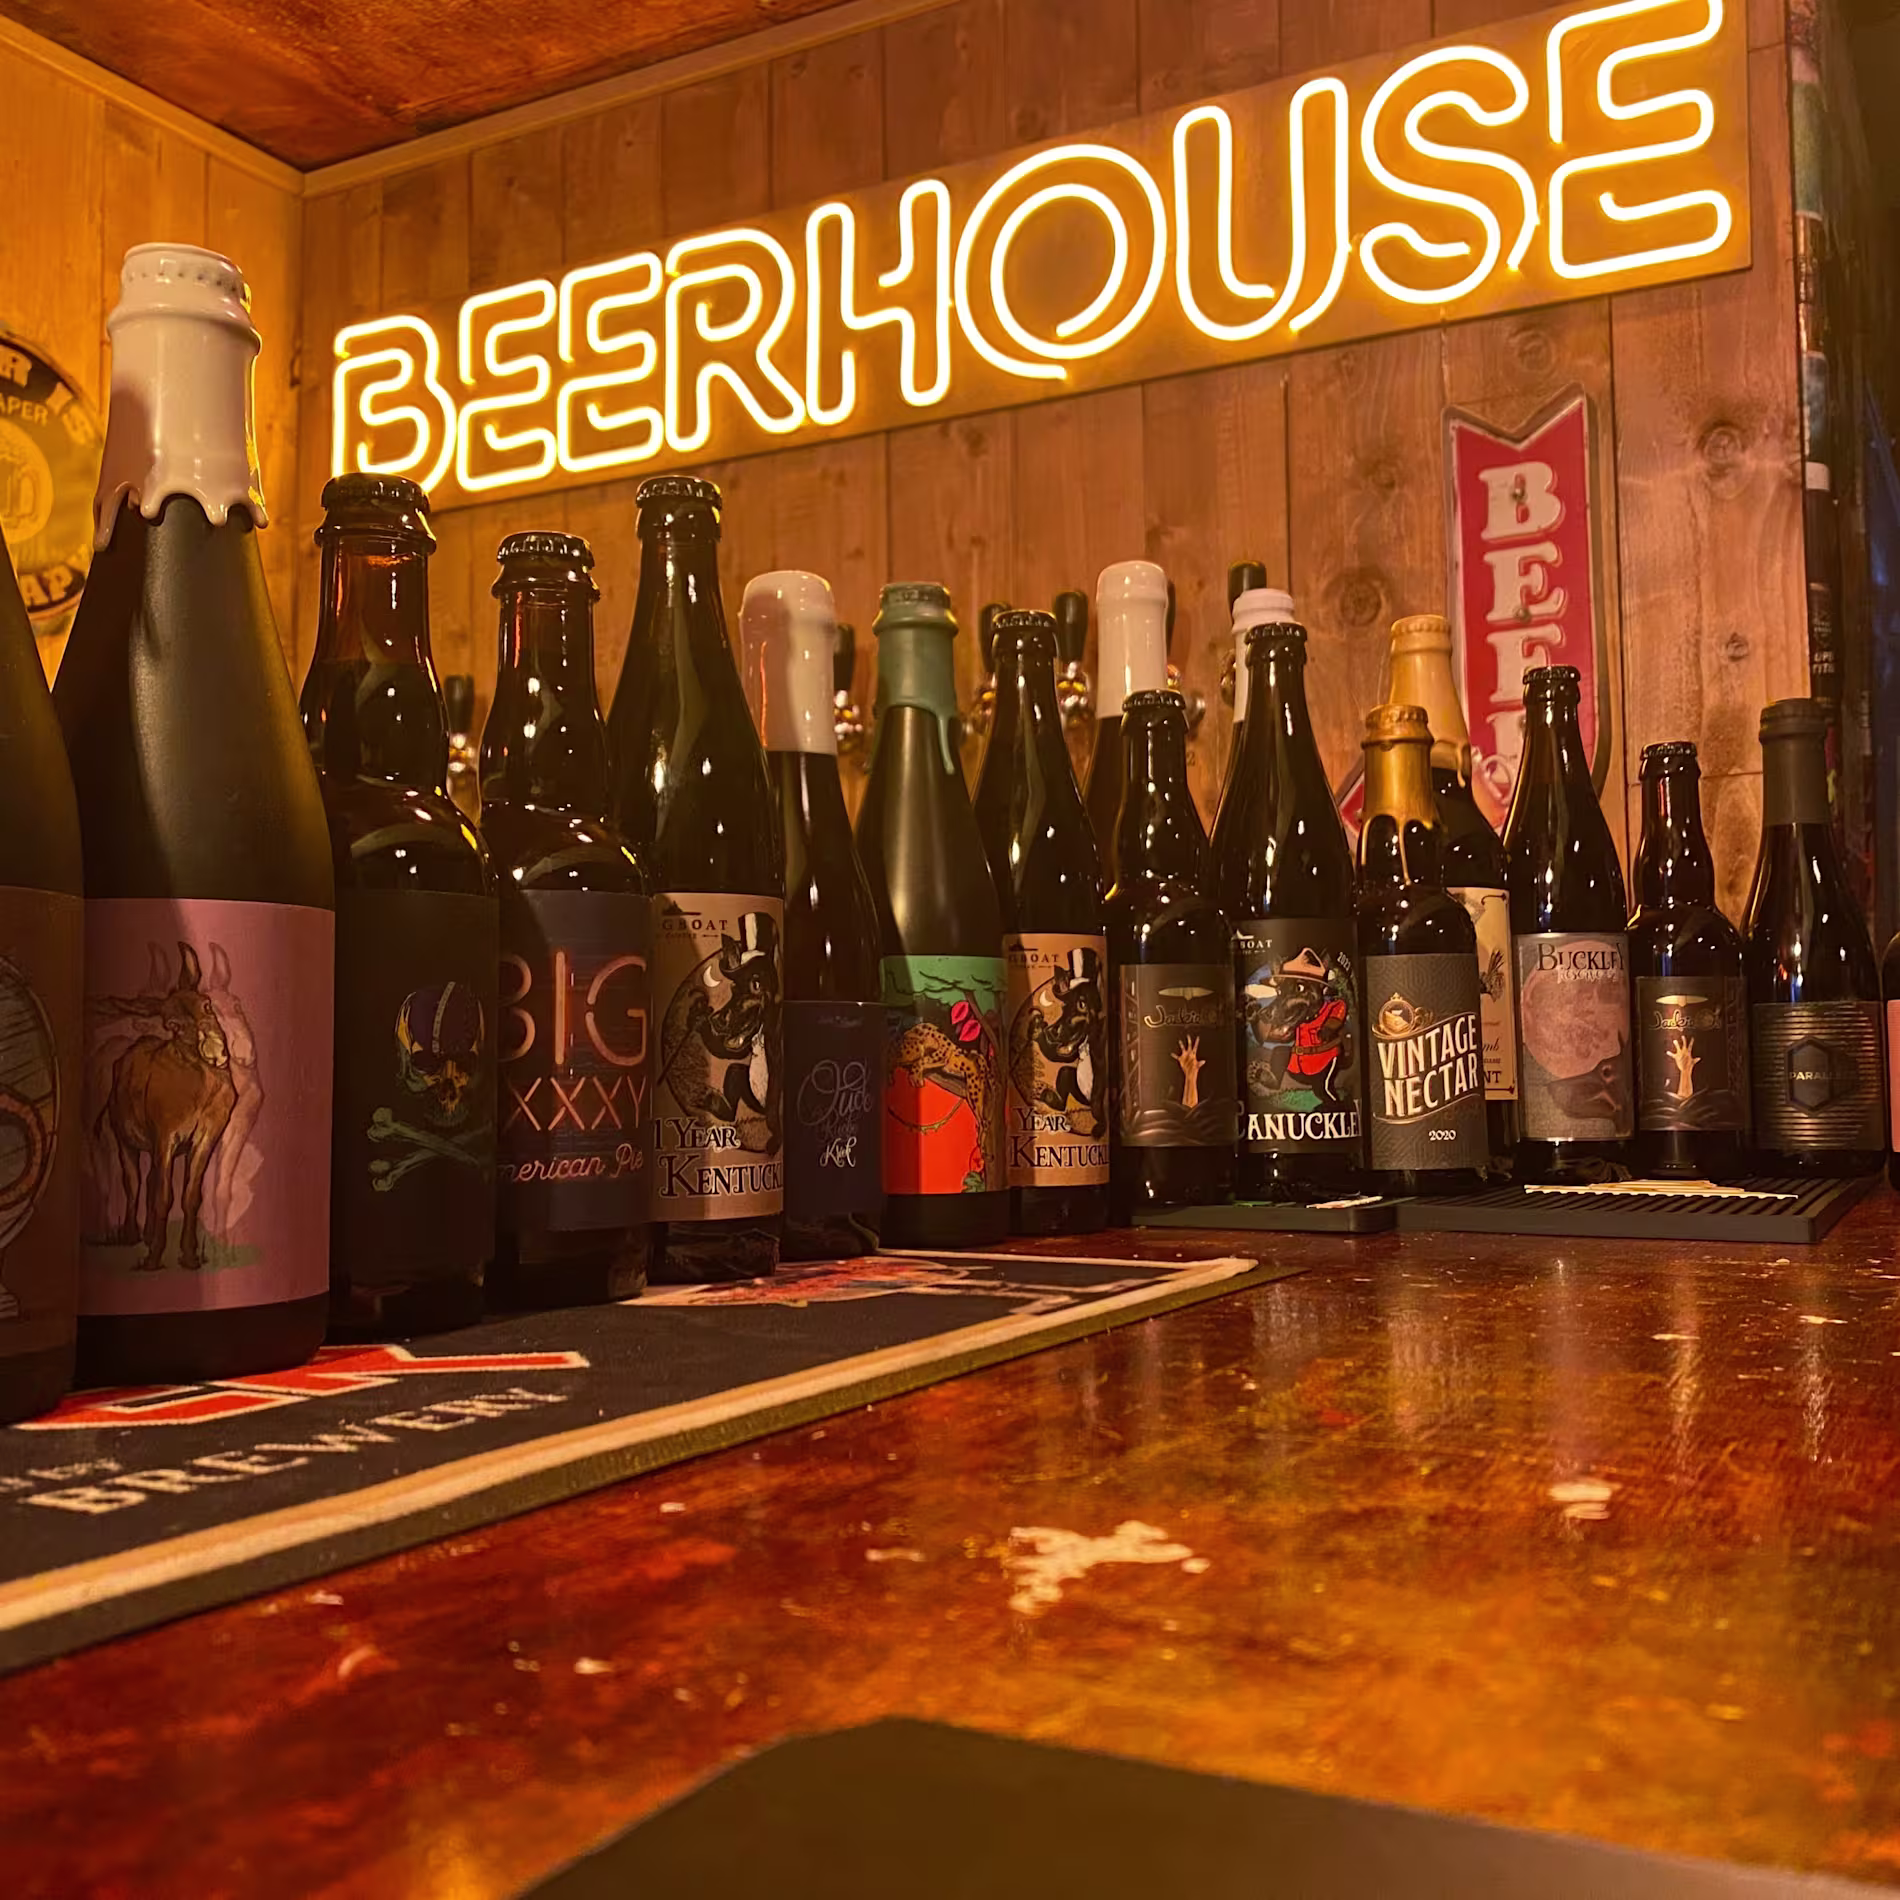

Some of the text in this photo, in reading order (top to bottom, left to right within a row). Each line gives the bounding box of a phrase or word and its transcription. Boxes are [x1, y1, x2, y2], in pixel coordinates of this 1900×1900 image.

[325, 0, 1735, 493] BEERHOUSE
[497, 950, 648, 1067] BIG
[1377, 1014, 1478, 1079] VINTAGE
[1383, 1052, 1479, 1118] NECTAR
[666, 1117, 742, 1151] YEAR
[1012, 1106, 1071, 1133] YEAR
[1428, 1129, 1457, 1142] 2020
[17, 1386, 568, 1515] BREWERY
